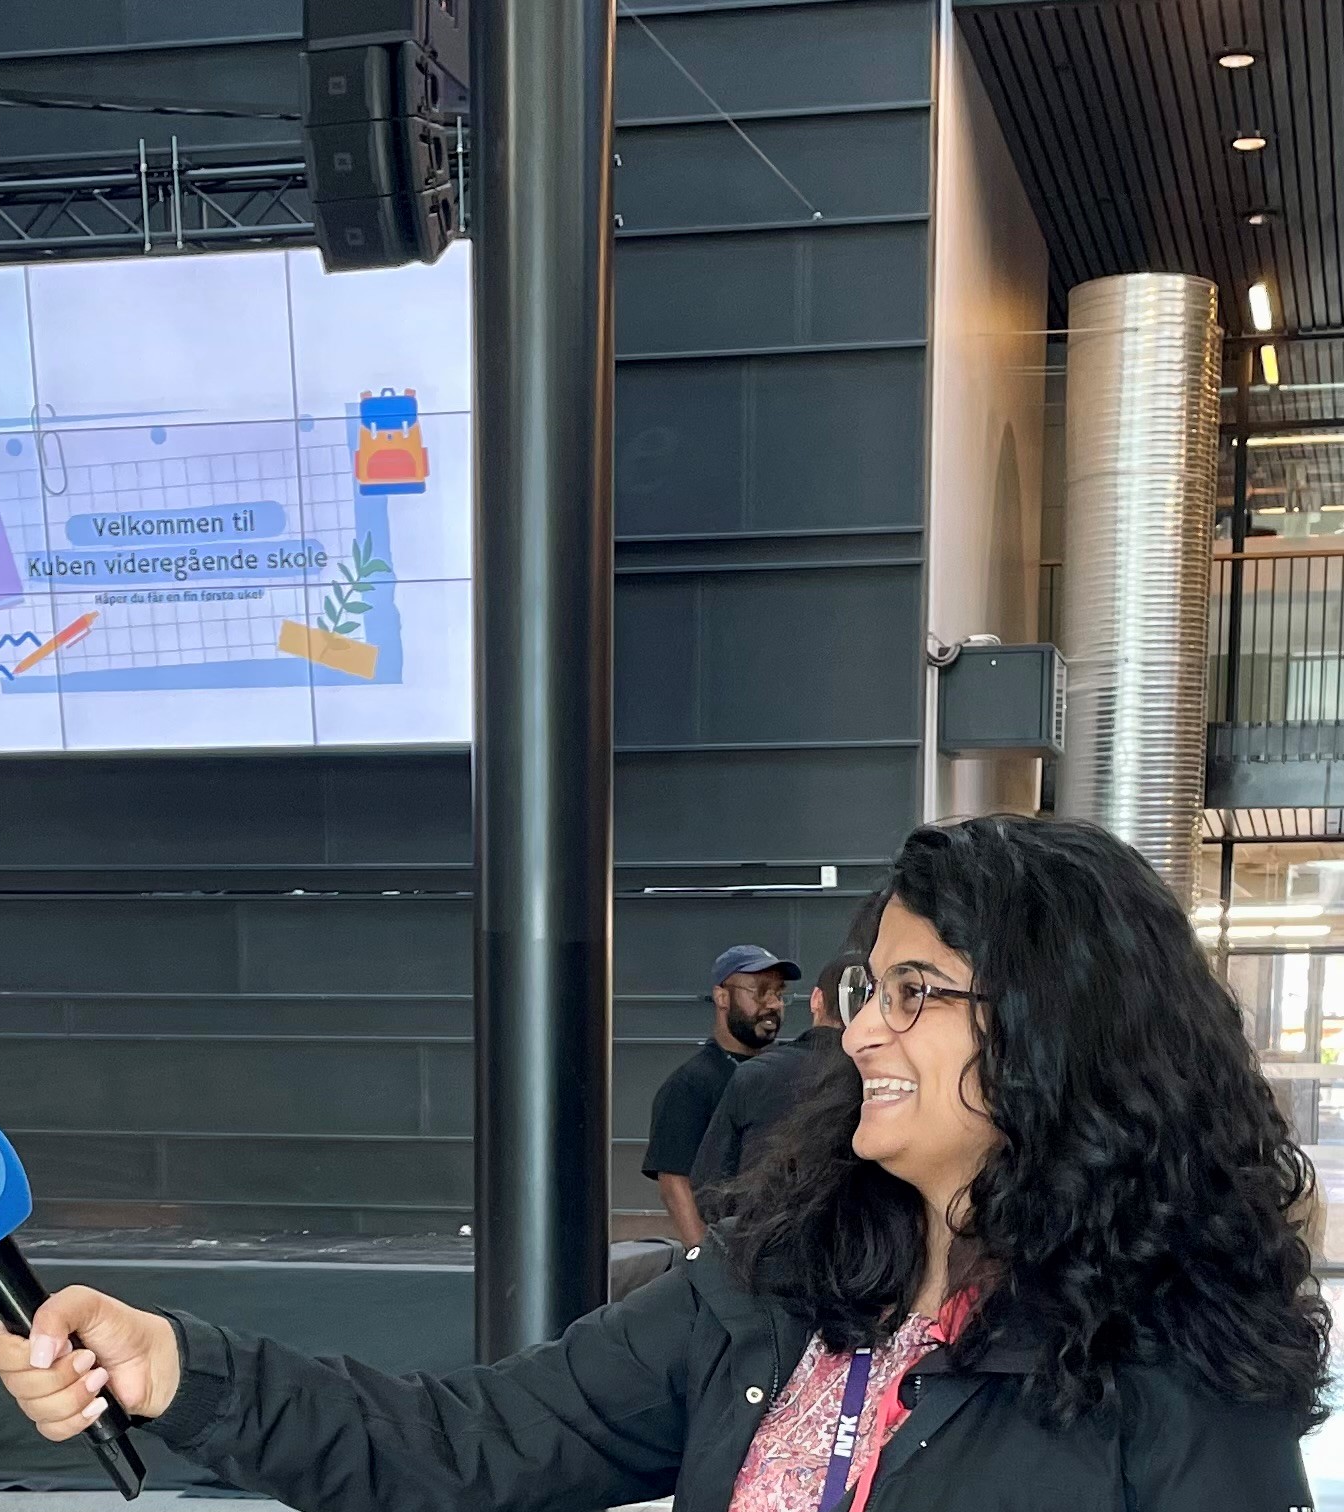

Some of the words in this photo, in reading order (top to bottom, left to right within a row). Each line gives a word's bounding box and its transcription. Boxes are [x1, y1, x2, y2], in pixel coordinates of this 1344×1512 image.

[92, 514, 225, 537] Velkommen
[232, 509, 256, 532] til
[27, 555, 97, 577] Kuben
[104, 548, 258, 581] videregående
[267, 546, 328, 569] skole
